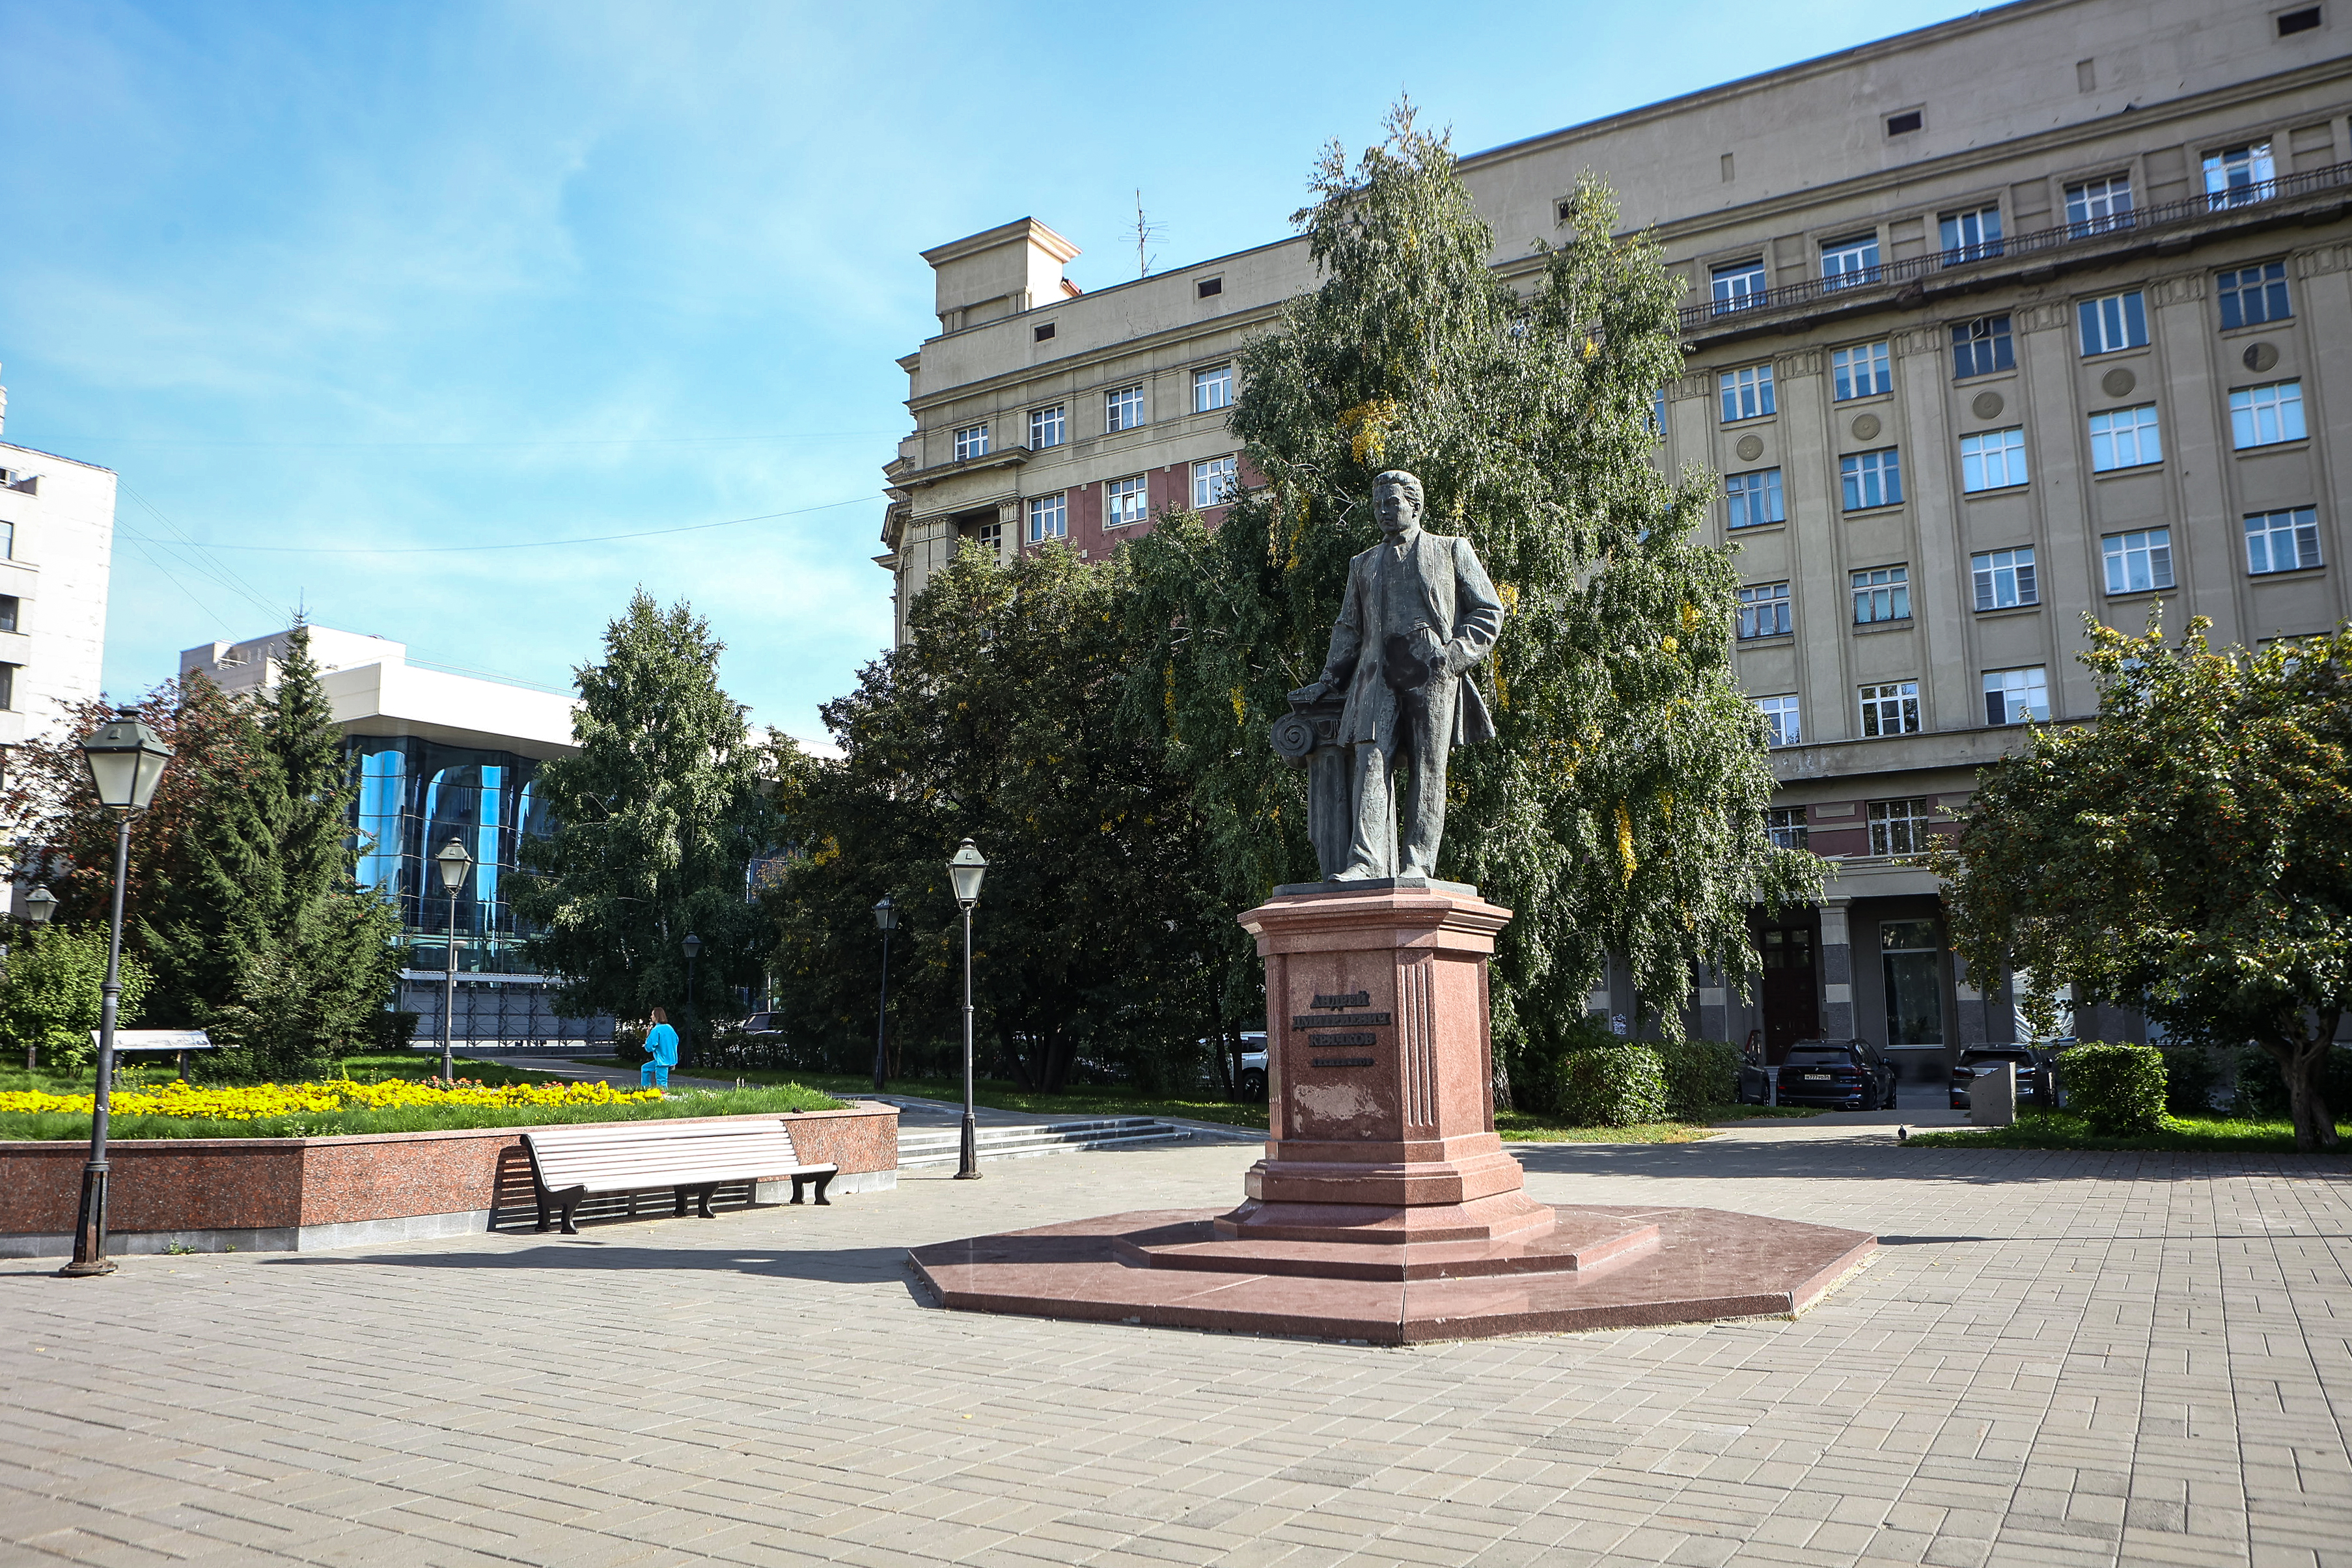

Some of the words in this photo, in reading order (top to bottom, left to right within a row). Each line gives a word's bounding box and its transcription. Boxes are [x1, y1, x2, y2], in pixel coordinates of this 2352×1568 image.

[1310, 991, 1370, 1011] АНДРЕЙ
[1292, 1012, 1391, 1032] ДМИТРИЕВИЧ
[1309, 1033, 1376, 1047] КРЯЧКОВ
